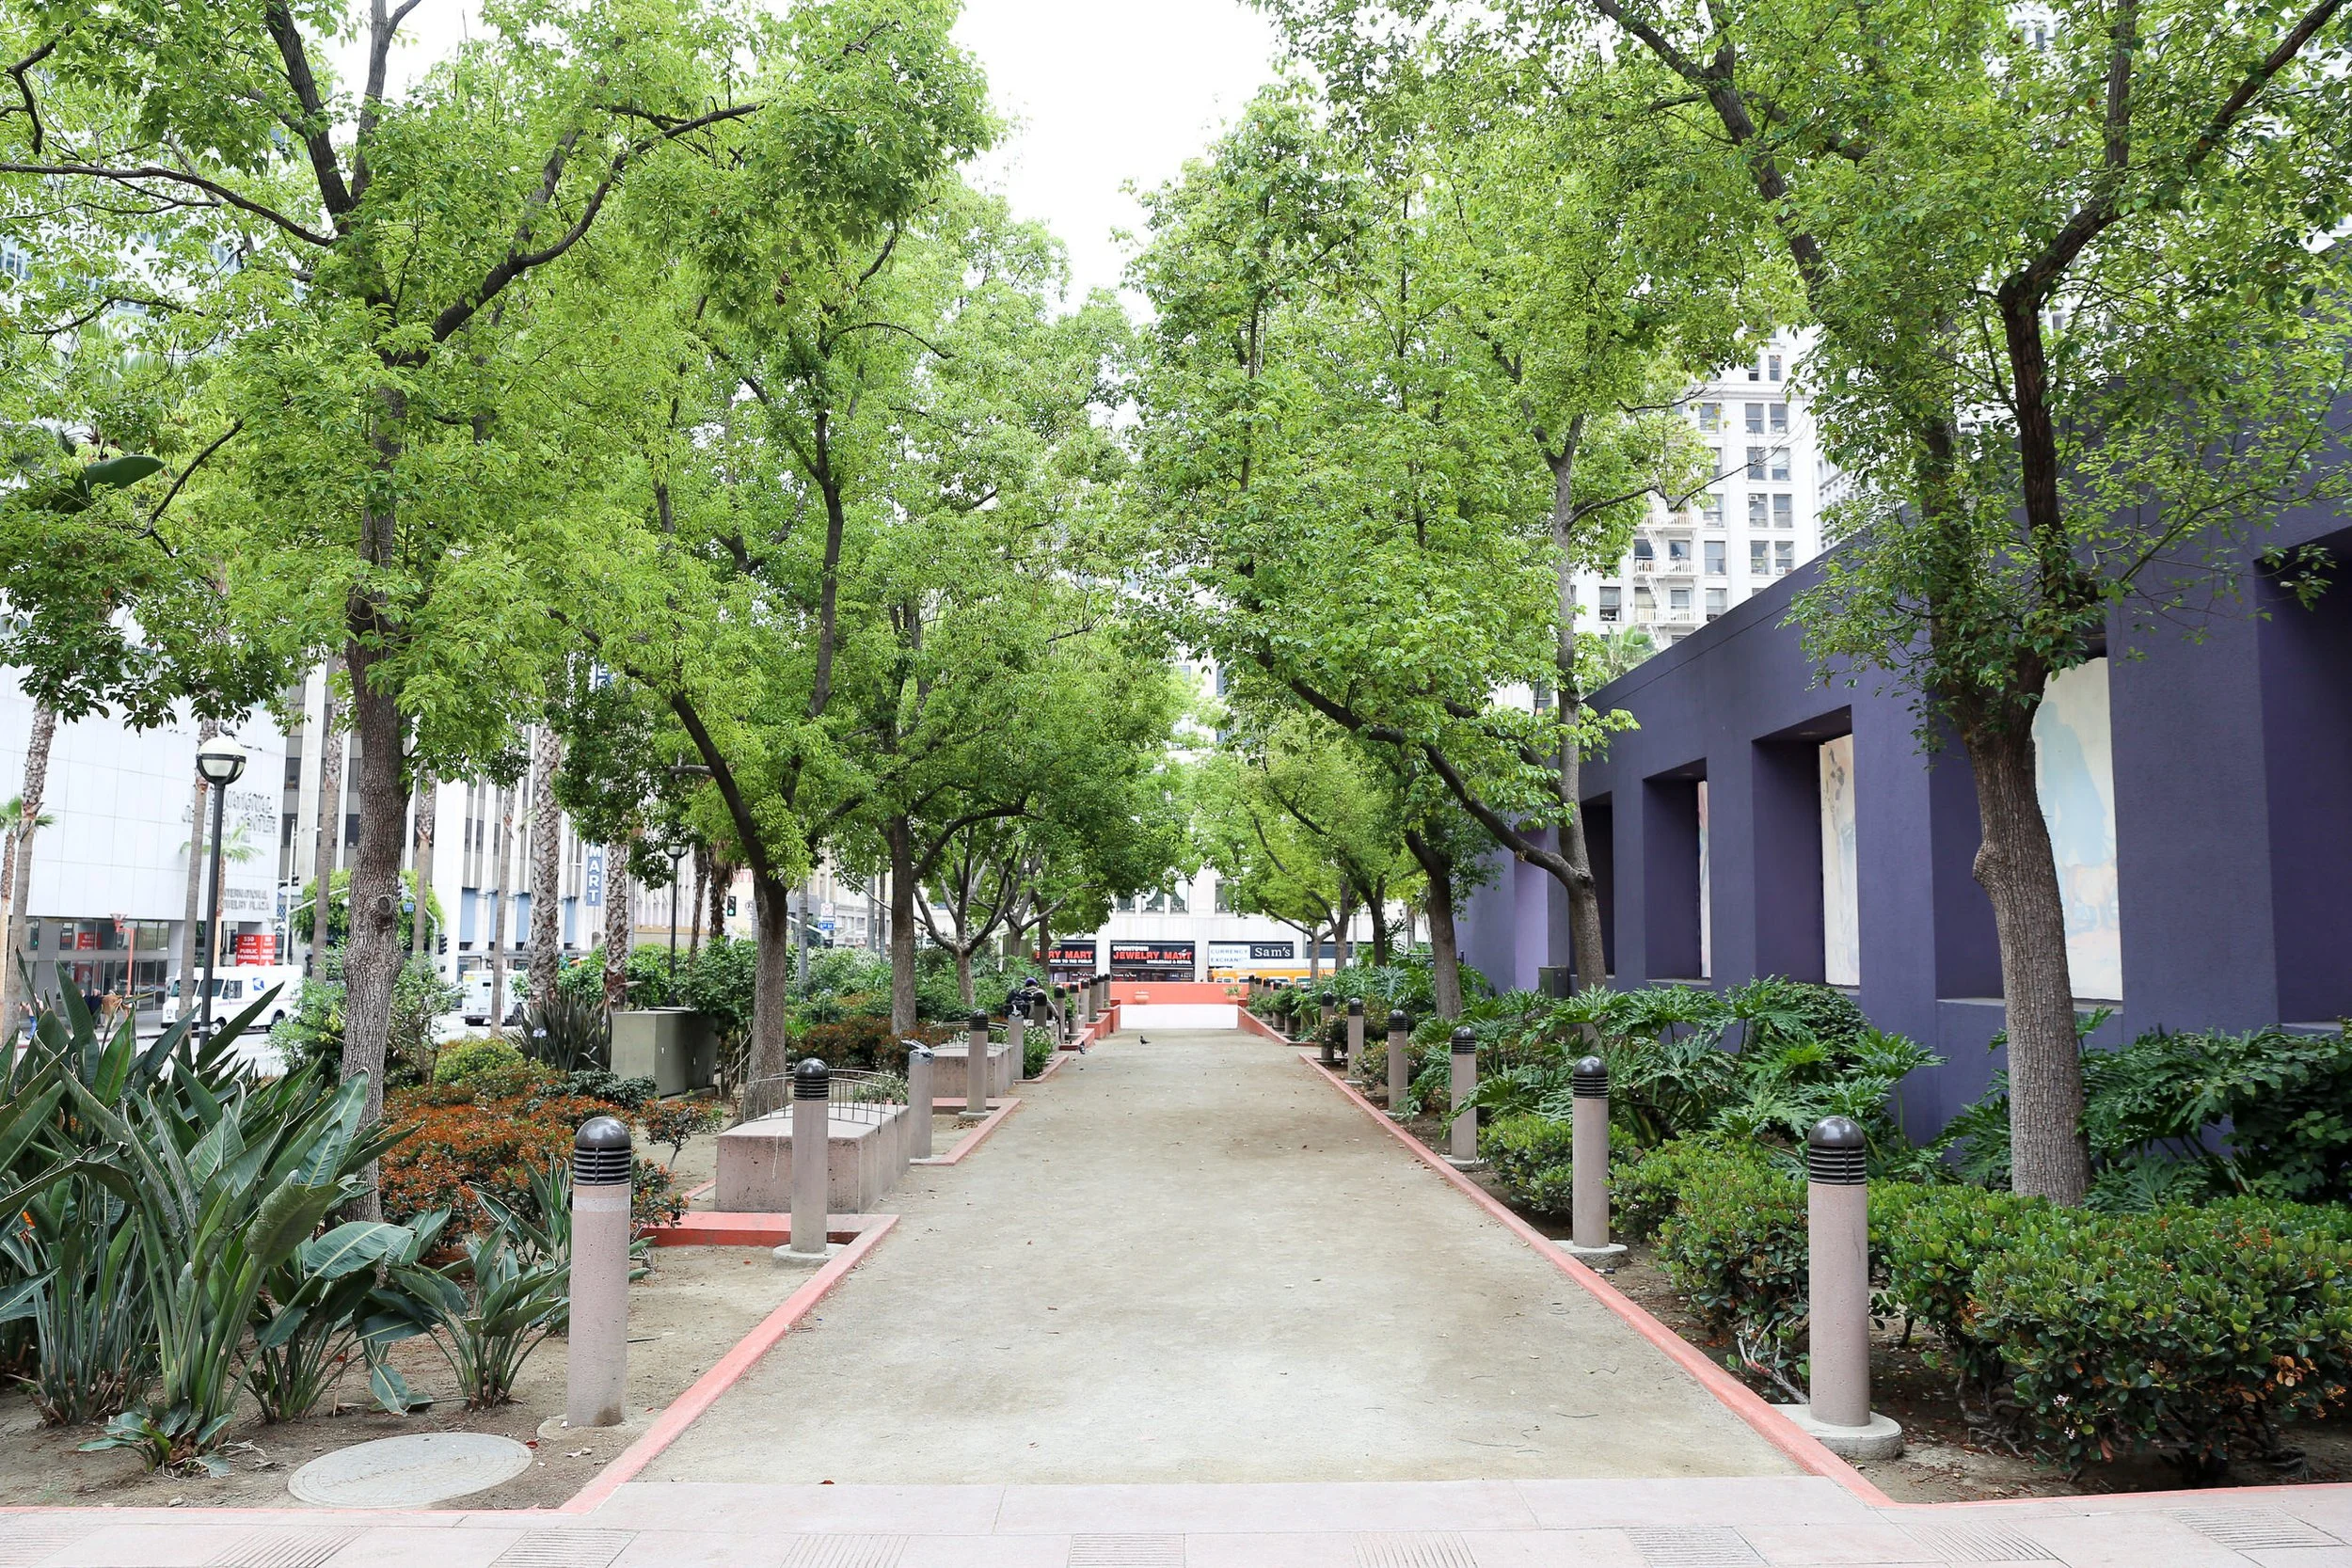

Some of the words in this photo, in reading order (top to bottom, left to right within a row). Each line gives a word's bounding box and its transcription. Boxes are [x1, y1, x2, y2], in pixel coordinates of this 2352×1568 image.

[588, 845, 601, 902] MART
[1064, 950, 1093, 959] MART
[1113, 951, 1160, 959] JEWELRY
[1164, 951, 1193, 960] MART
[1254, 946, 1291, 958] Sam's
